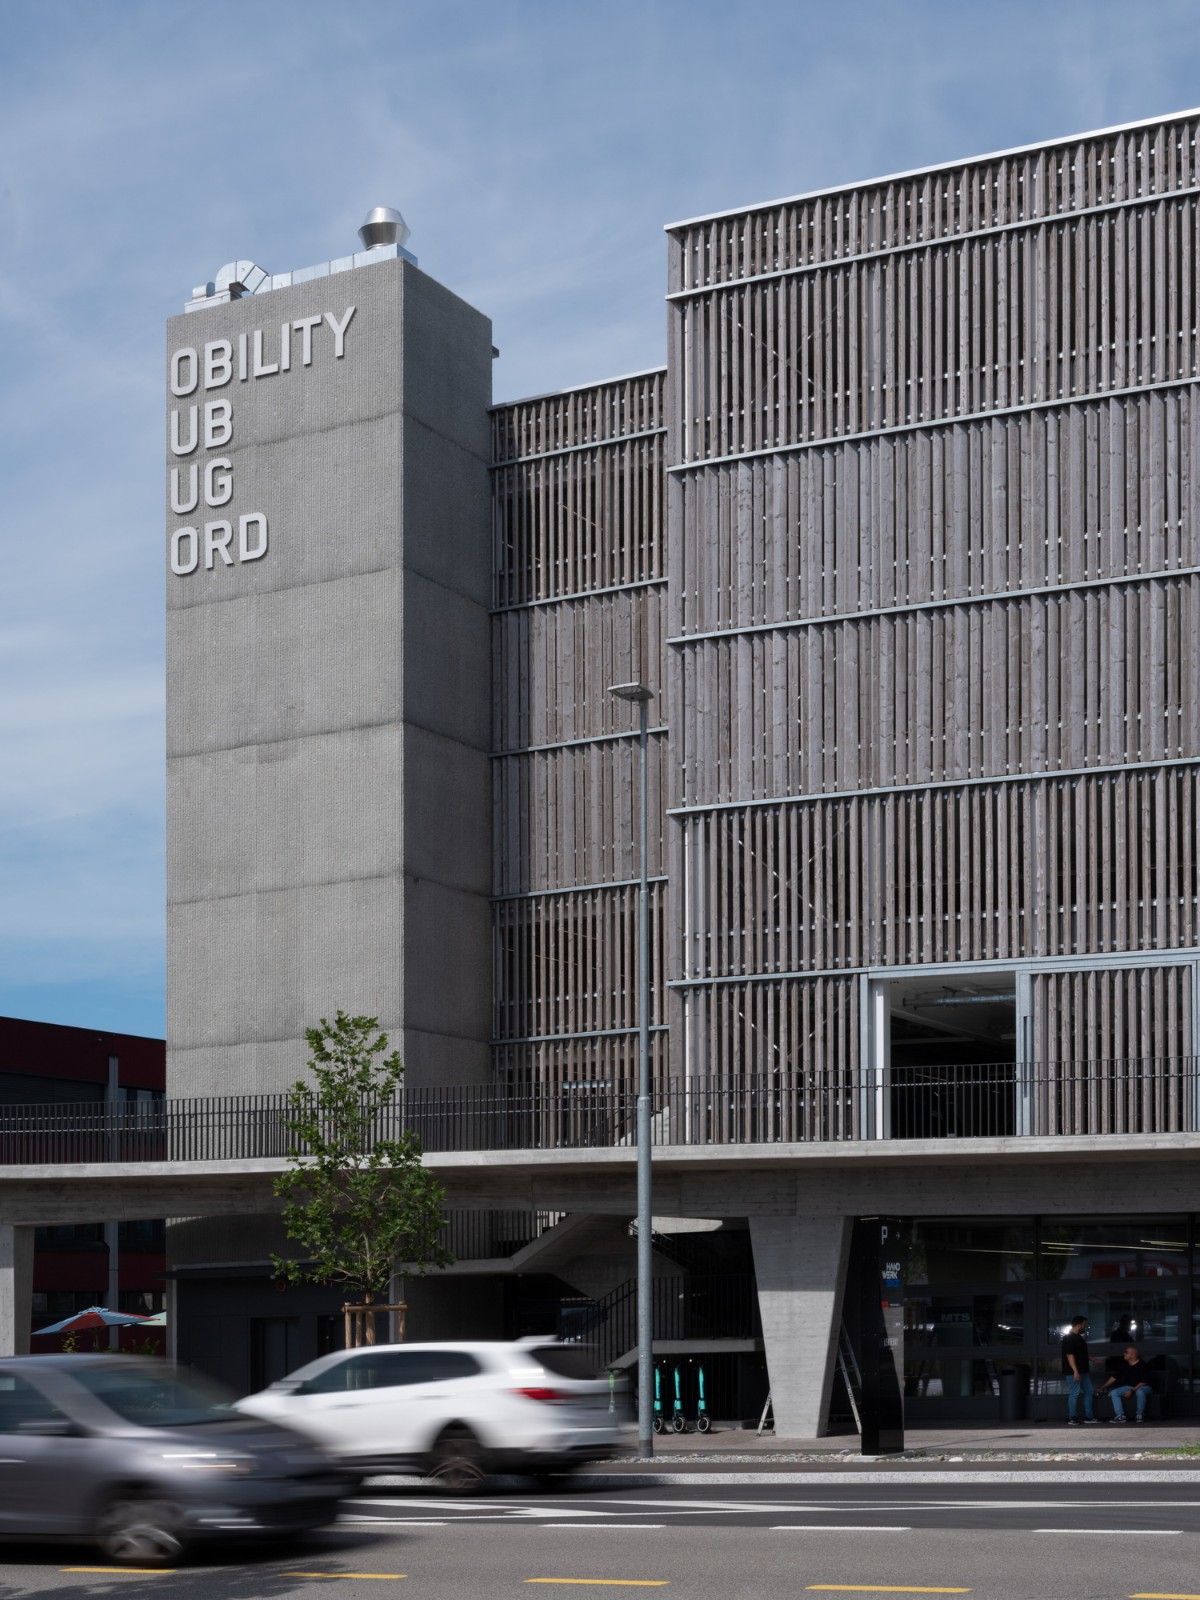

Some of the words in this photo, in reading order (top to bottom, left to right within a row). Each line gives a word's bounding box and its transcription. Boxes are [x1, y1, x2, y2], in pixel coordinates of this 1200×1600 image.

[171, 306, 356, 397] OBILITY
[171, 398, 233, 456] UB
[171, 457, 233, 514] UG
[171, 511, 268, 576] ORD
[881, 1226, 888, 1245] P
[882, 1271, 898, 1279] WERK
[941, 1313, 970, 1322] MTS
